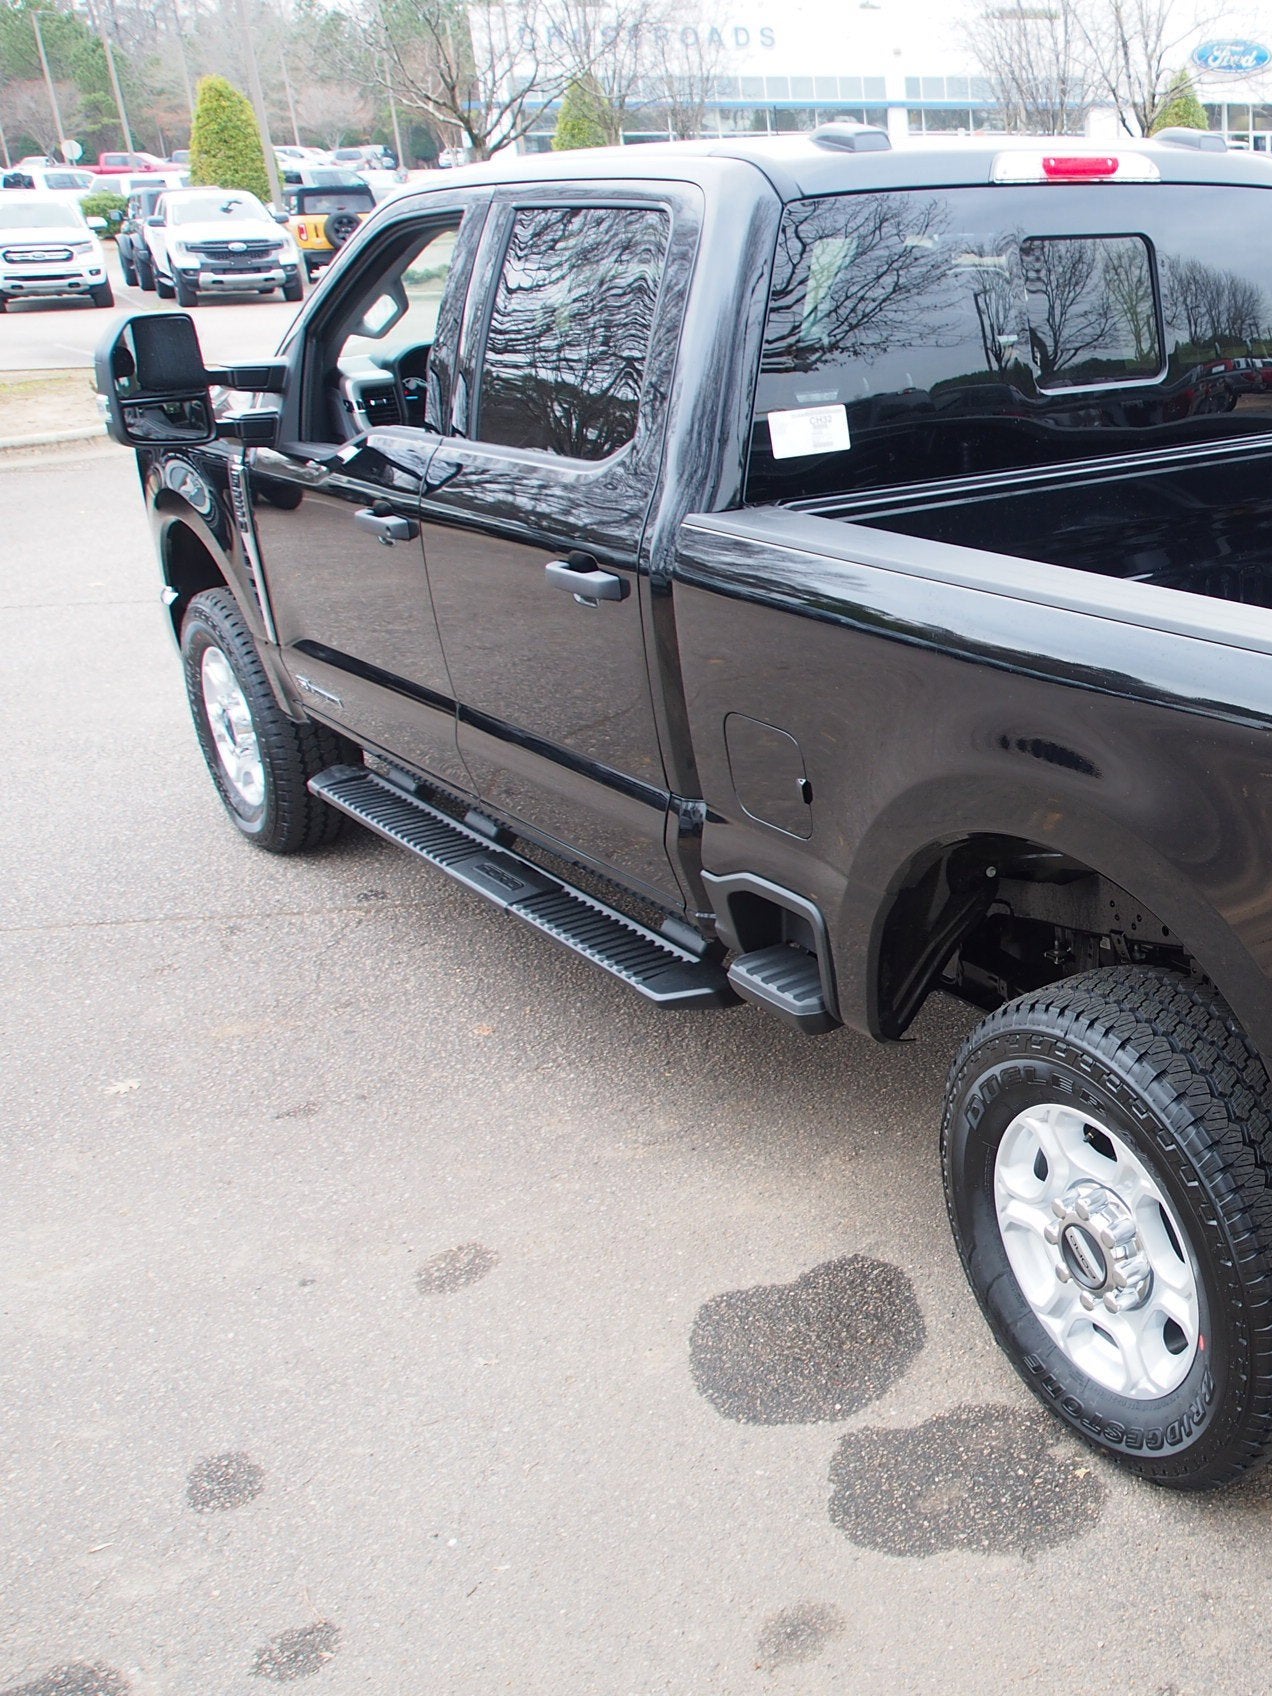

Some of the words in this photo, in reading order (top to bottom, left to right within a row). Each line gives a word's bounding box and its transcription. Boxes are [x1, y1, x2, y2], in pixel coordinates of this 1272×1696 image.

[1207, 45, 1258, 67] Ford
[964, 1066, 1107, 1131] DUELER
[1023, 1353, 1216, 1451] BRIDGESTONE
